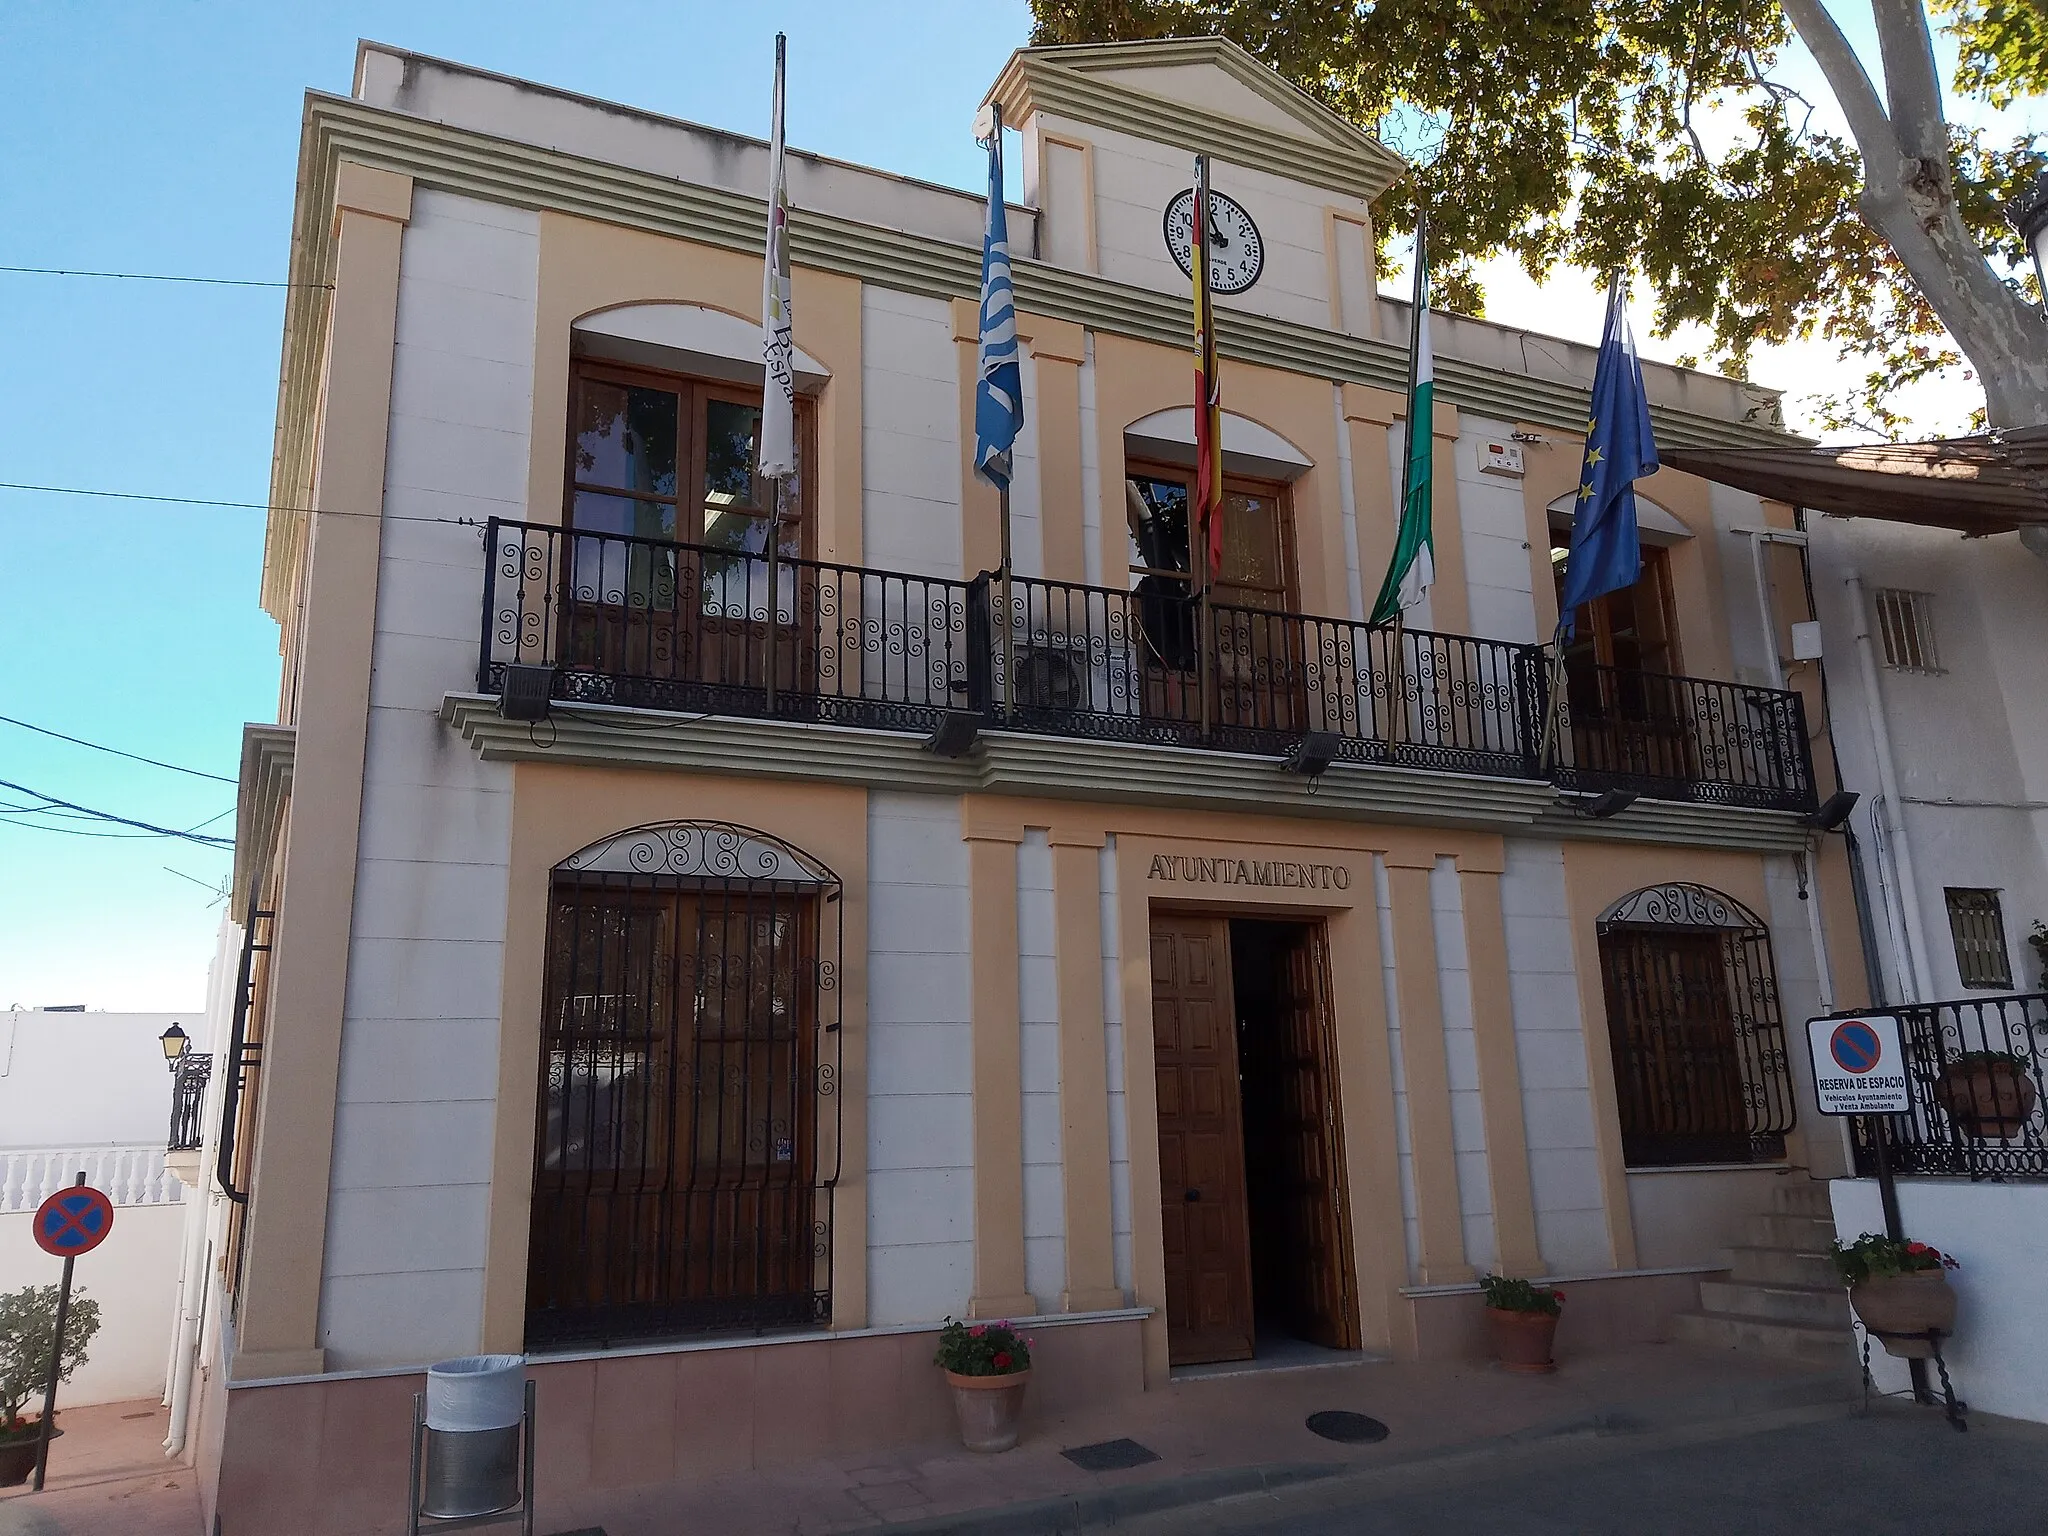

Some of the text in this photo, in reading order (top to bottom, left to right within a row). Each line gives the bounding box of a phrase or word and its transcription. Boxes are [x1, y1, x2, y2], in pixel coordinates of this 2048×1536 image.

[1180, 212, 1192, 226] 10
[1225, 211, 1231, 223] 1
[1176, 226, 1184, 239] 9
[1238, 225, 1246, 238] 2
[1183, 245, 1191, 258] 8
[1244, 244, 1252, 257] 3
[1240, 260, 1247, 273] 4
[1212, 268, 1220, 281] 6
[1227, 268, 1235, 281] 5
[763, 340, 793, 405] Espa
[1147, 854, 1350, 890] AYUNTAMIENTO
[1819, 1076, 1904, 1090] RESERVA DE ESPACIO
[1857, 1093, 1902, 1102] Ayuntamiento
[1834, 1104, 1839, 1112] y
[1860, 1102, 1895, 1110] Ambulante
